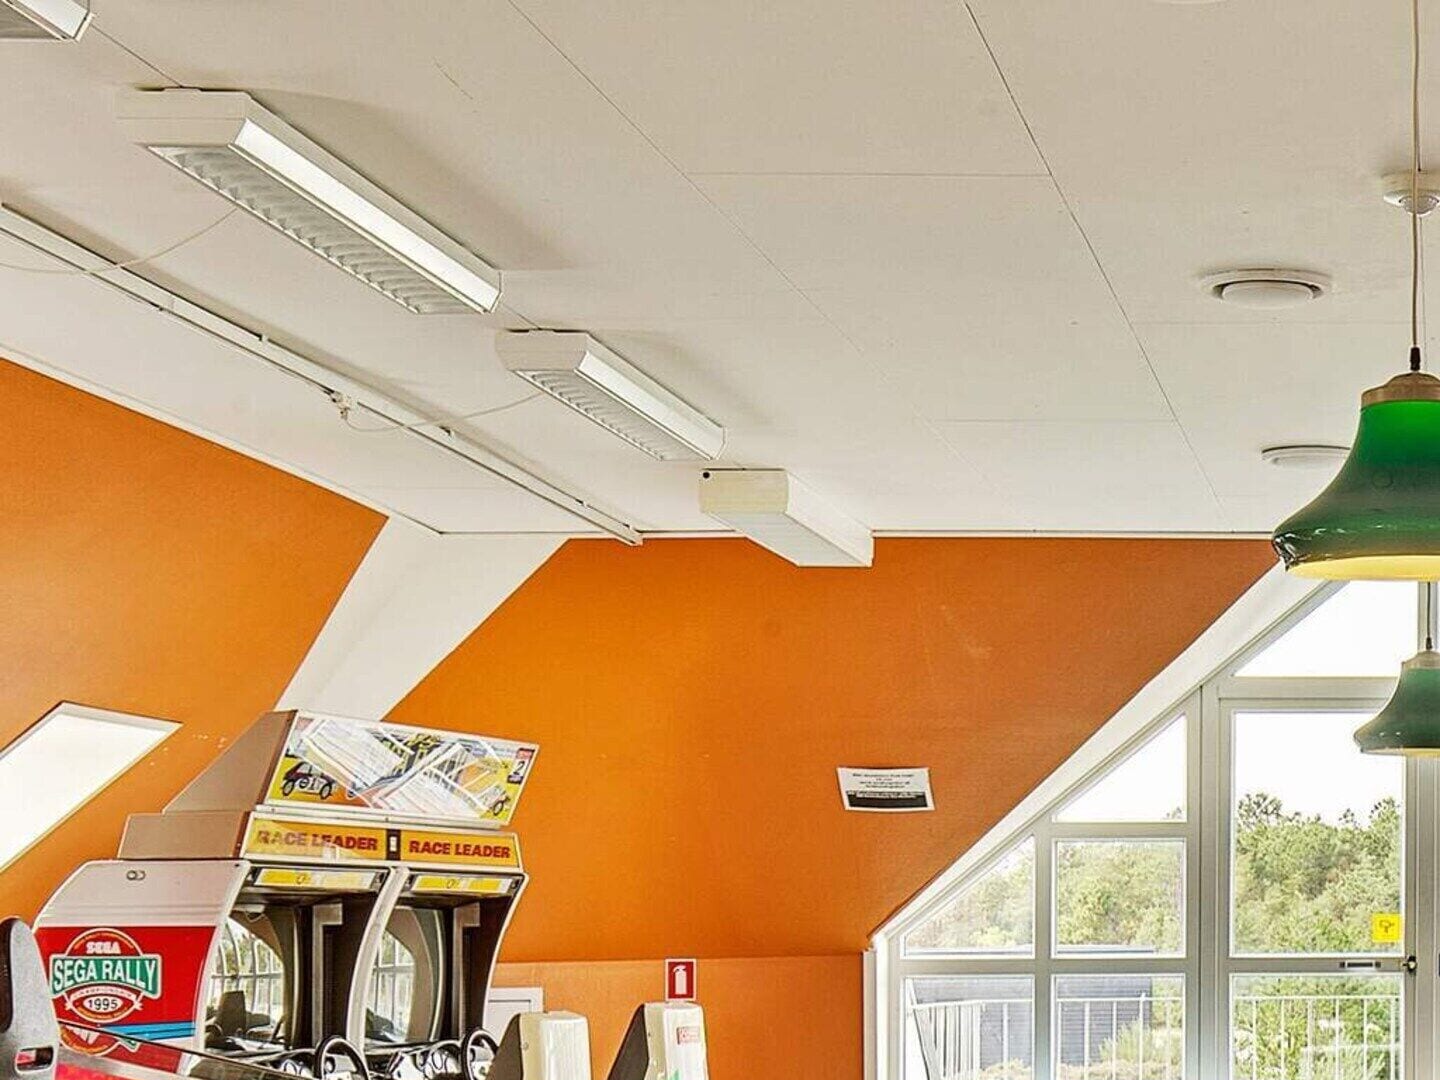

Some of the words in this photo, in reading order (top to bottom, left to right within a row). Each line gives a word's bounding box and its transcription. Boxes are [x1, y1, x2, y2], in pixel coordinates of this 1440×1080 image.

[257, 830, 308, 847] RACE
[312, 834, 378, 851] LEADER
[409, 840, 451, 855] RACE
[455, 843, 510, 858] LEADER
[86, 941, 121, 955] SEGA
[53, 959, 98, 991] SEGA
[102, 958, 156, 991] RALLY
[88, 998, 118, 1011] 1995
